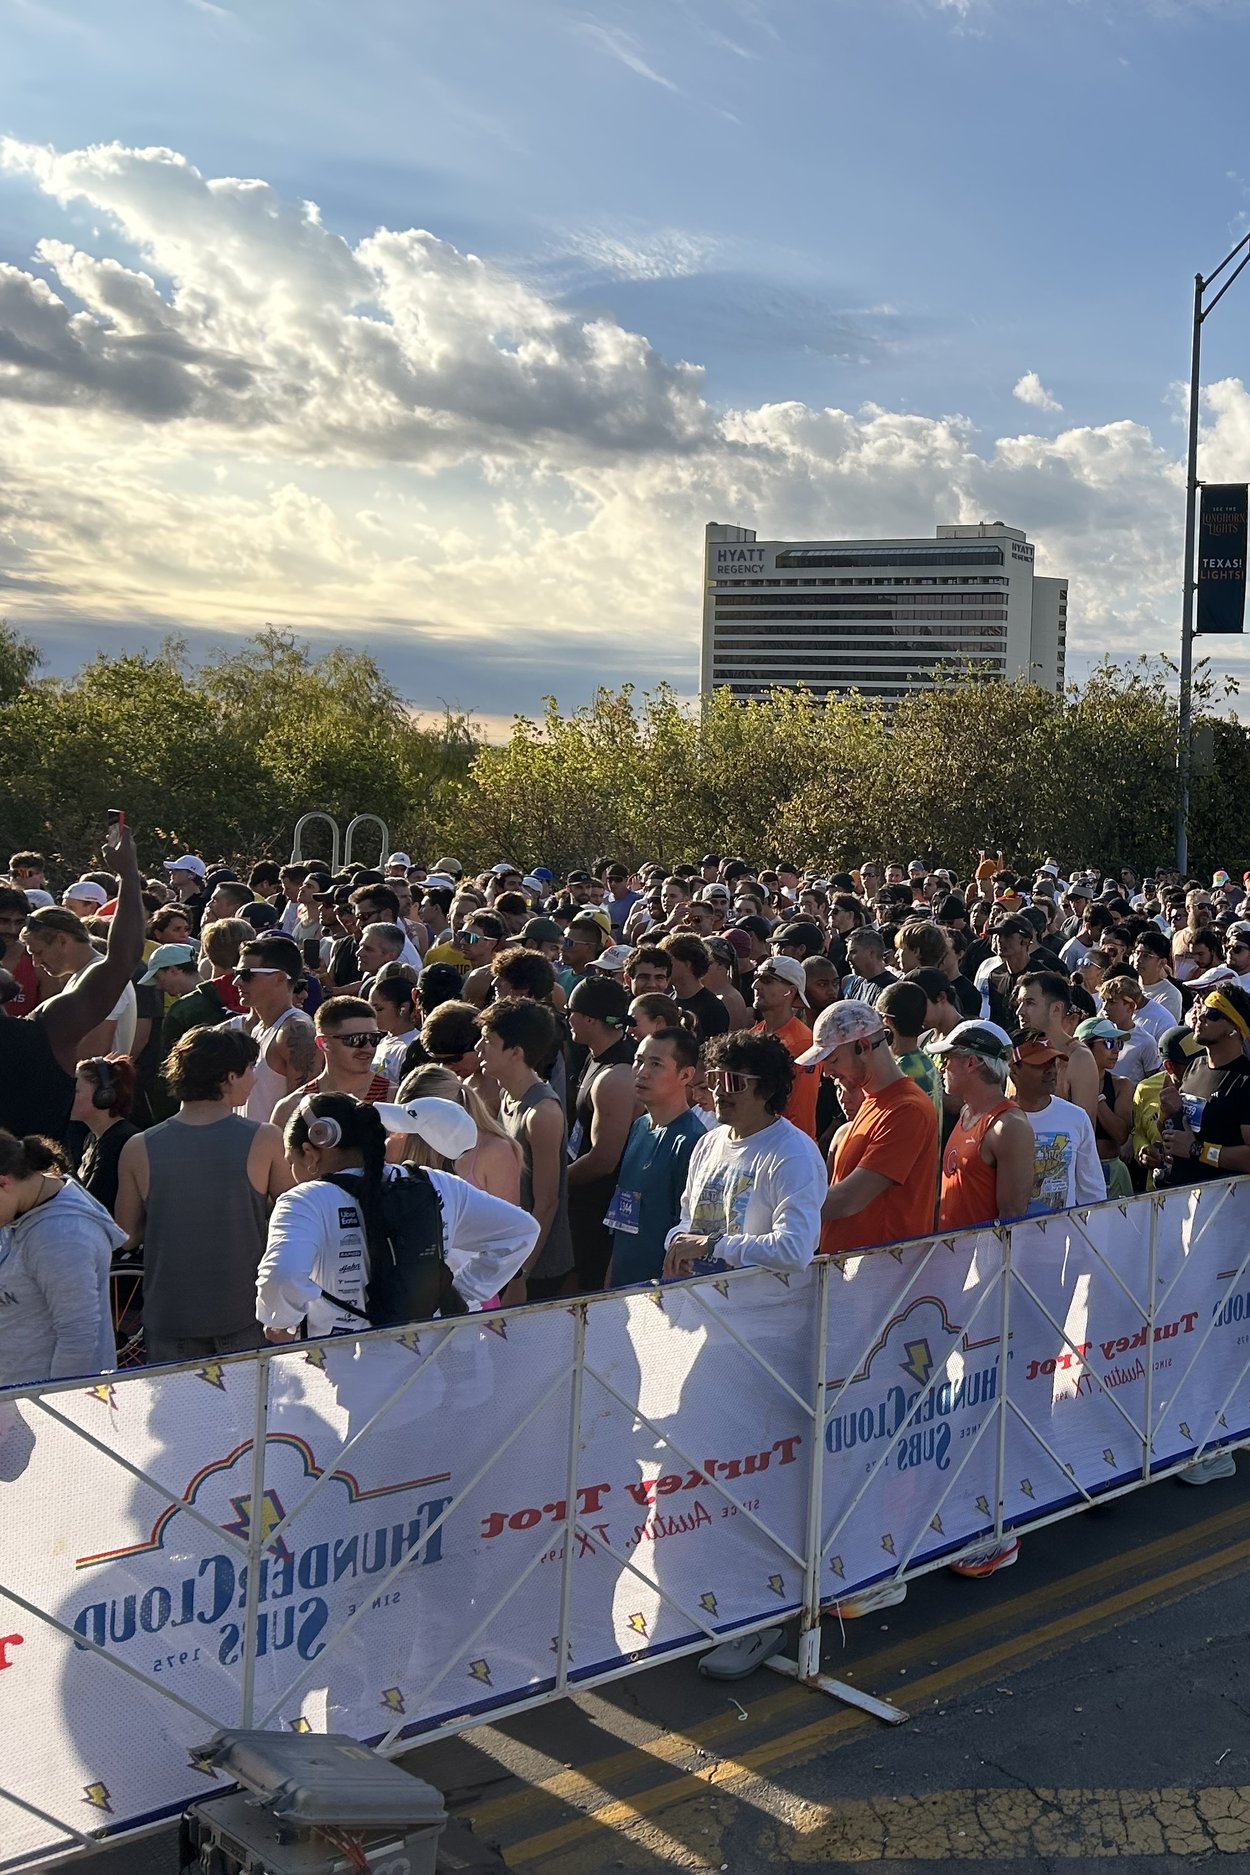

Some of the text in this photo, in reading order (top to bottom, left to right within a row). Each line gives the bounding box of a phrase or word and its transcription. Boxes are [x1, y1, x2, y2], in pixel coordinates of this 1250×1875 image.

[1209, 523, 1238, 536] LIGHTS
[718, 549, 766, 562] HYATT
[1203, 558, 1242, 568] TEXAS!
[717, 564, 765, 574] REGENCY
[1200, 570, 1244, 580] LIGHTS!
